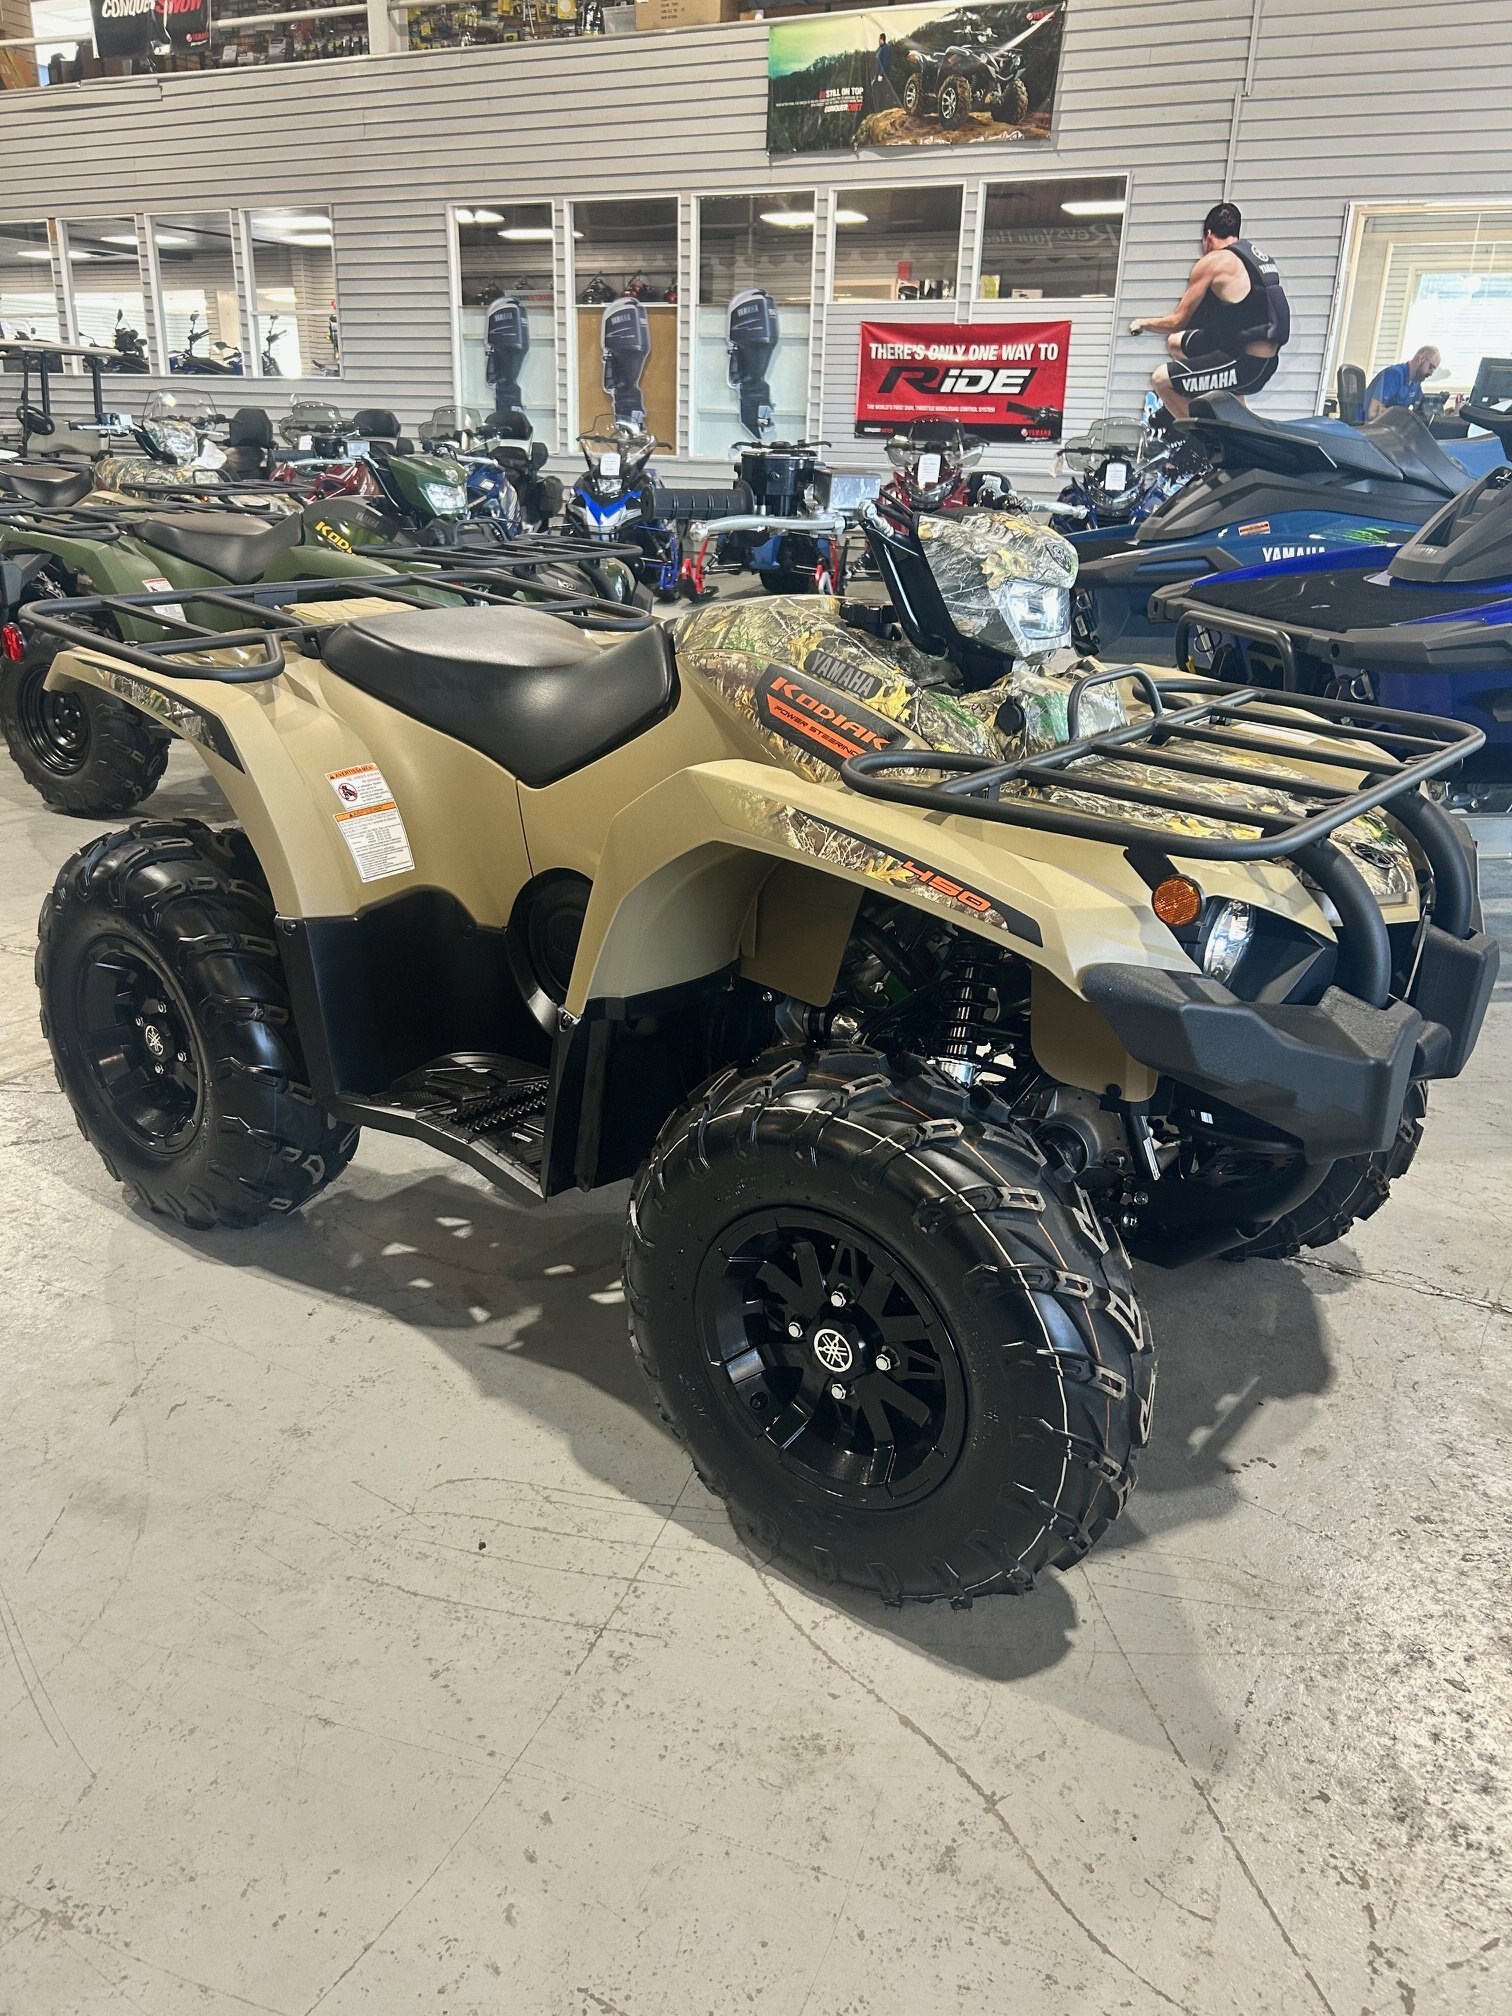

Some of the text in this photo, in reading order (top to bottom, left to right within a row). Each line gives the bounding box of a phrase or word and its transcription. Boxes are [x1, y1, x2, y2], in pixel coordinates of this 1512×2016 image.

[825, 87, 864, 98] STILL ON TOP
[869, 343, 1059, 361] THERE'S ONLY ONE WAY TO
[1181, 368, 1238, 392] YAMAHA
[315, 521, 352, 554] KOD
[811, 652, 875, 697] YAMAHA
[769, 676, 891, 751] KODIAK
[774, 705, 809, 728] POWER
[902, 860, 992, 912] 450
